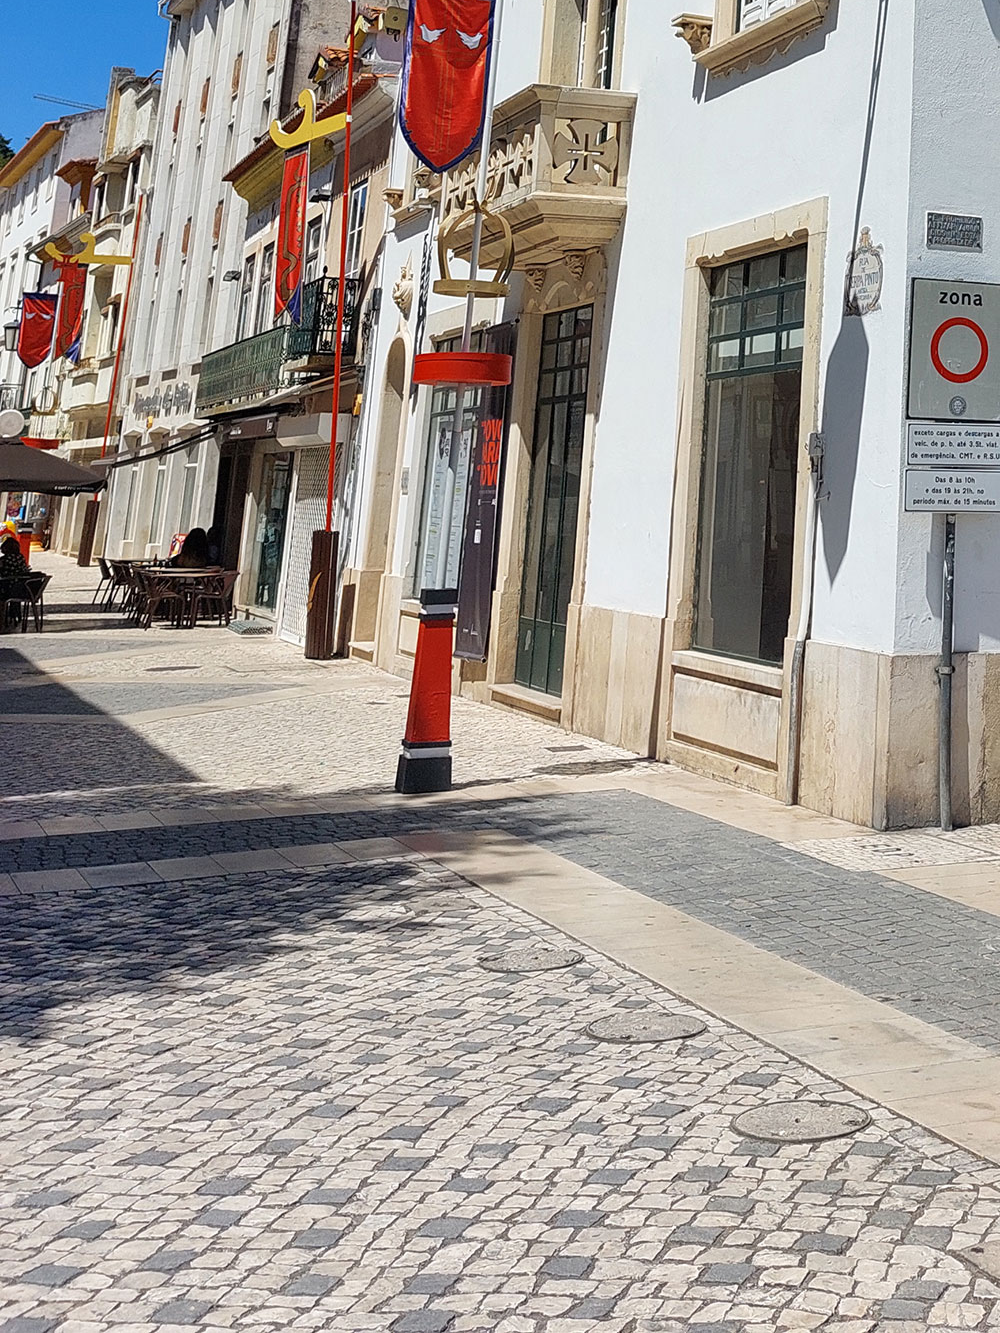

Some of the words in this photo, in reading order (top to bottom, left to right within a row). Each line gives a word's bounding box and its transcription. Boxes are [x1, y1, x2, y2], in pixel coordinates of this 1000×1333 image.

[939, 291, 982, 306] zona
[964, 430, 993, 438] descargas
[973, 498, 996, 506] minutos
